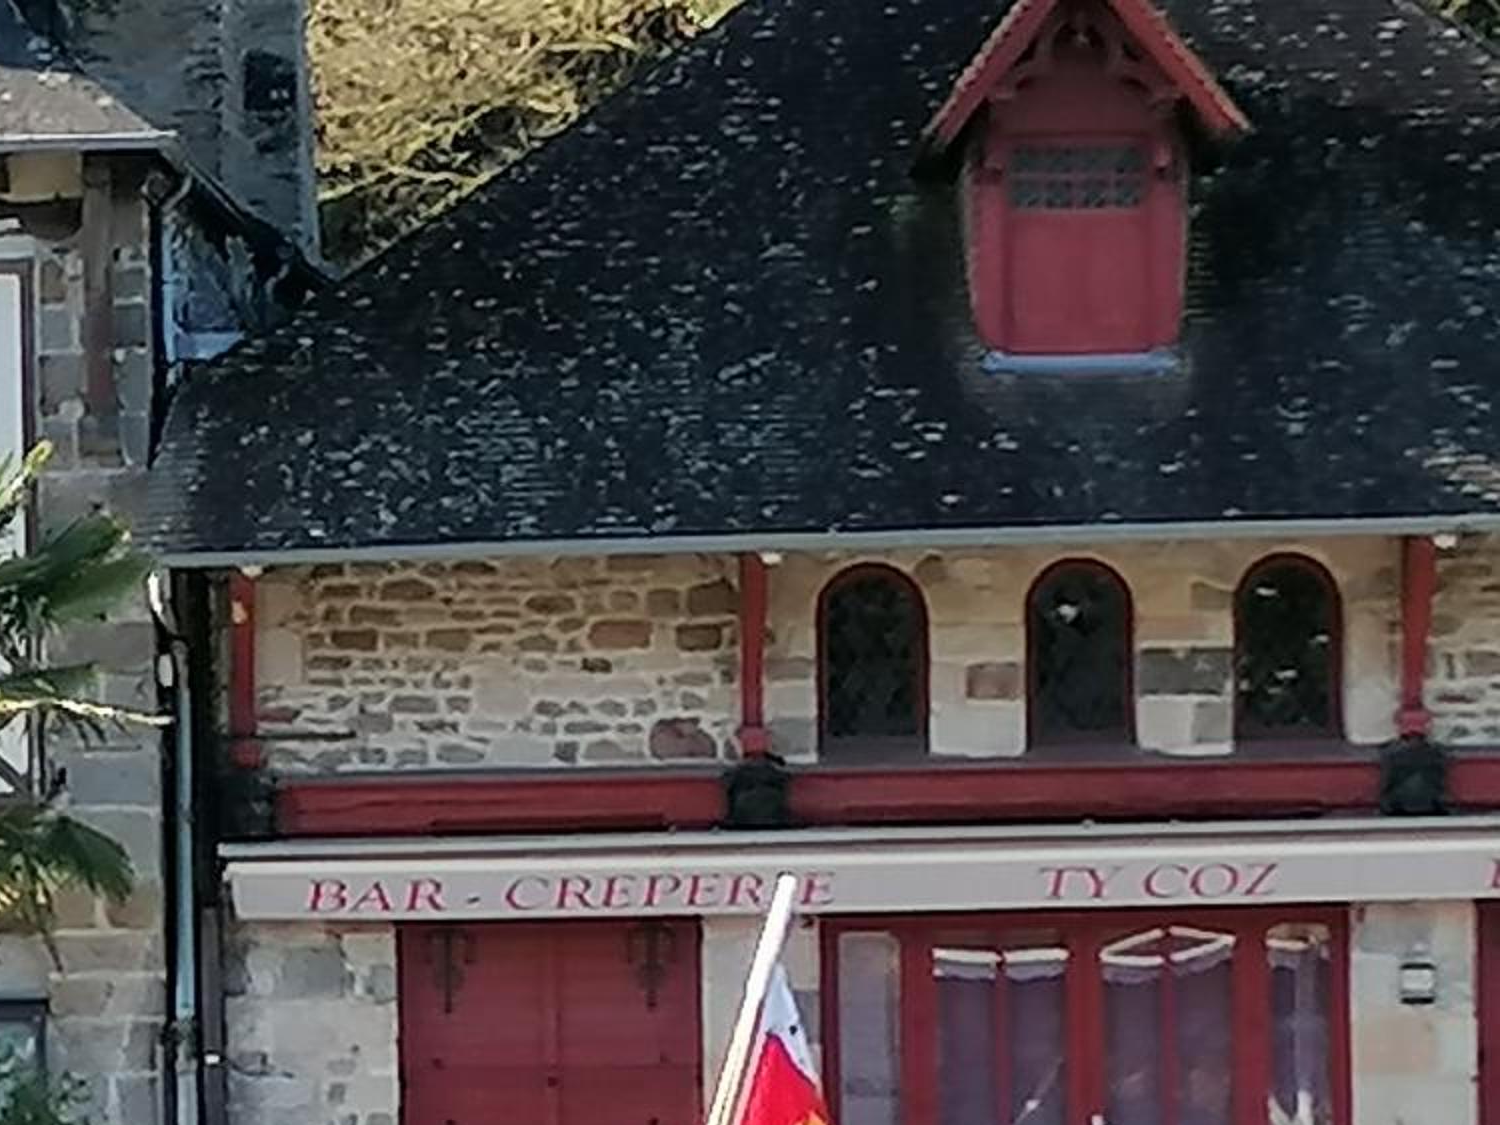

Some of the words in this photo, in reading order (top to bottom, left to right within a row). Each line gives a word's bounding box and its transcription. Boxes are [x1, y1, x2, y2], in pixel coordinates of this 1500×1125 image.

[309, 878, 446, 912] BAR
[504, 871, 836, 911] CREPERE
[1040, 865, 1122, 899] TY
[1143, 862, 1279, 898] COZ
